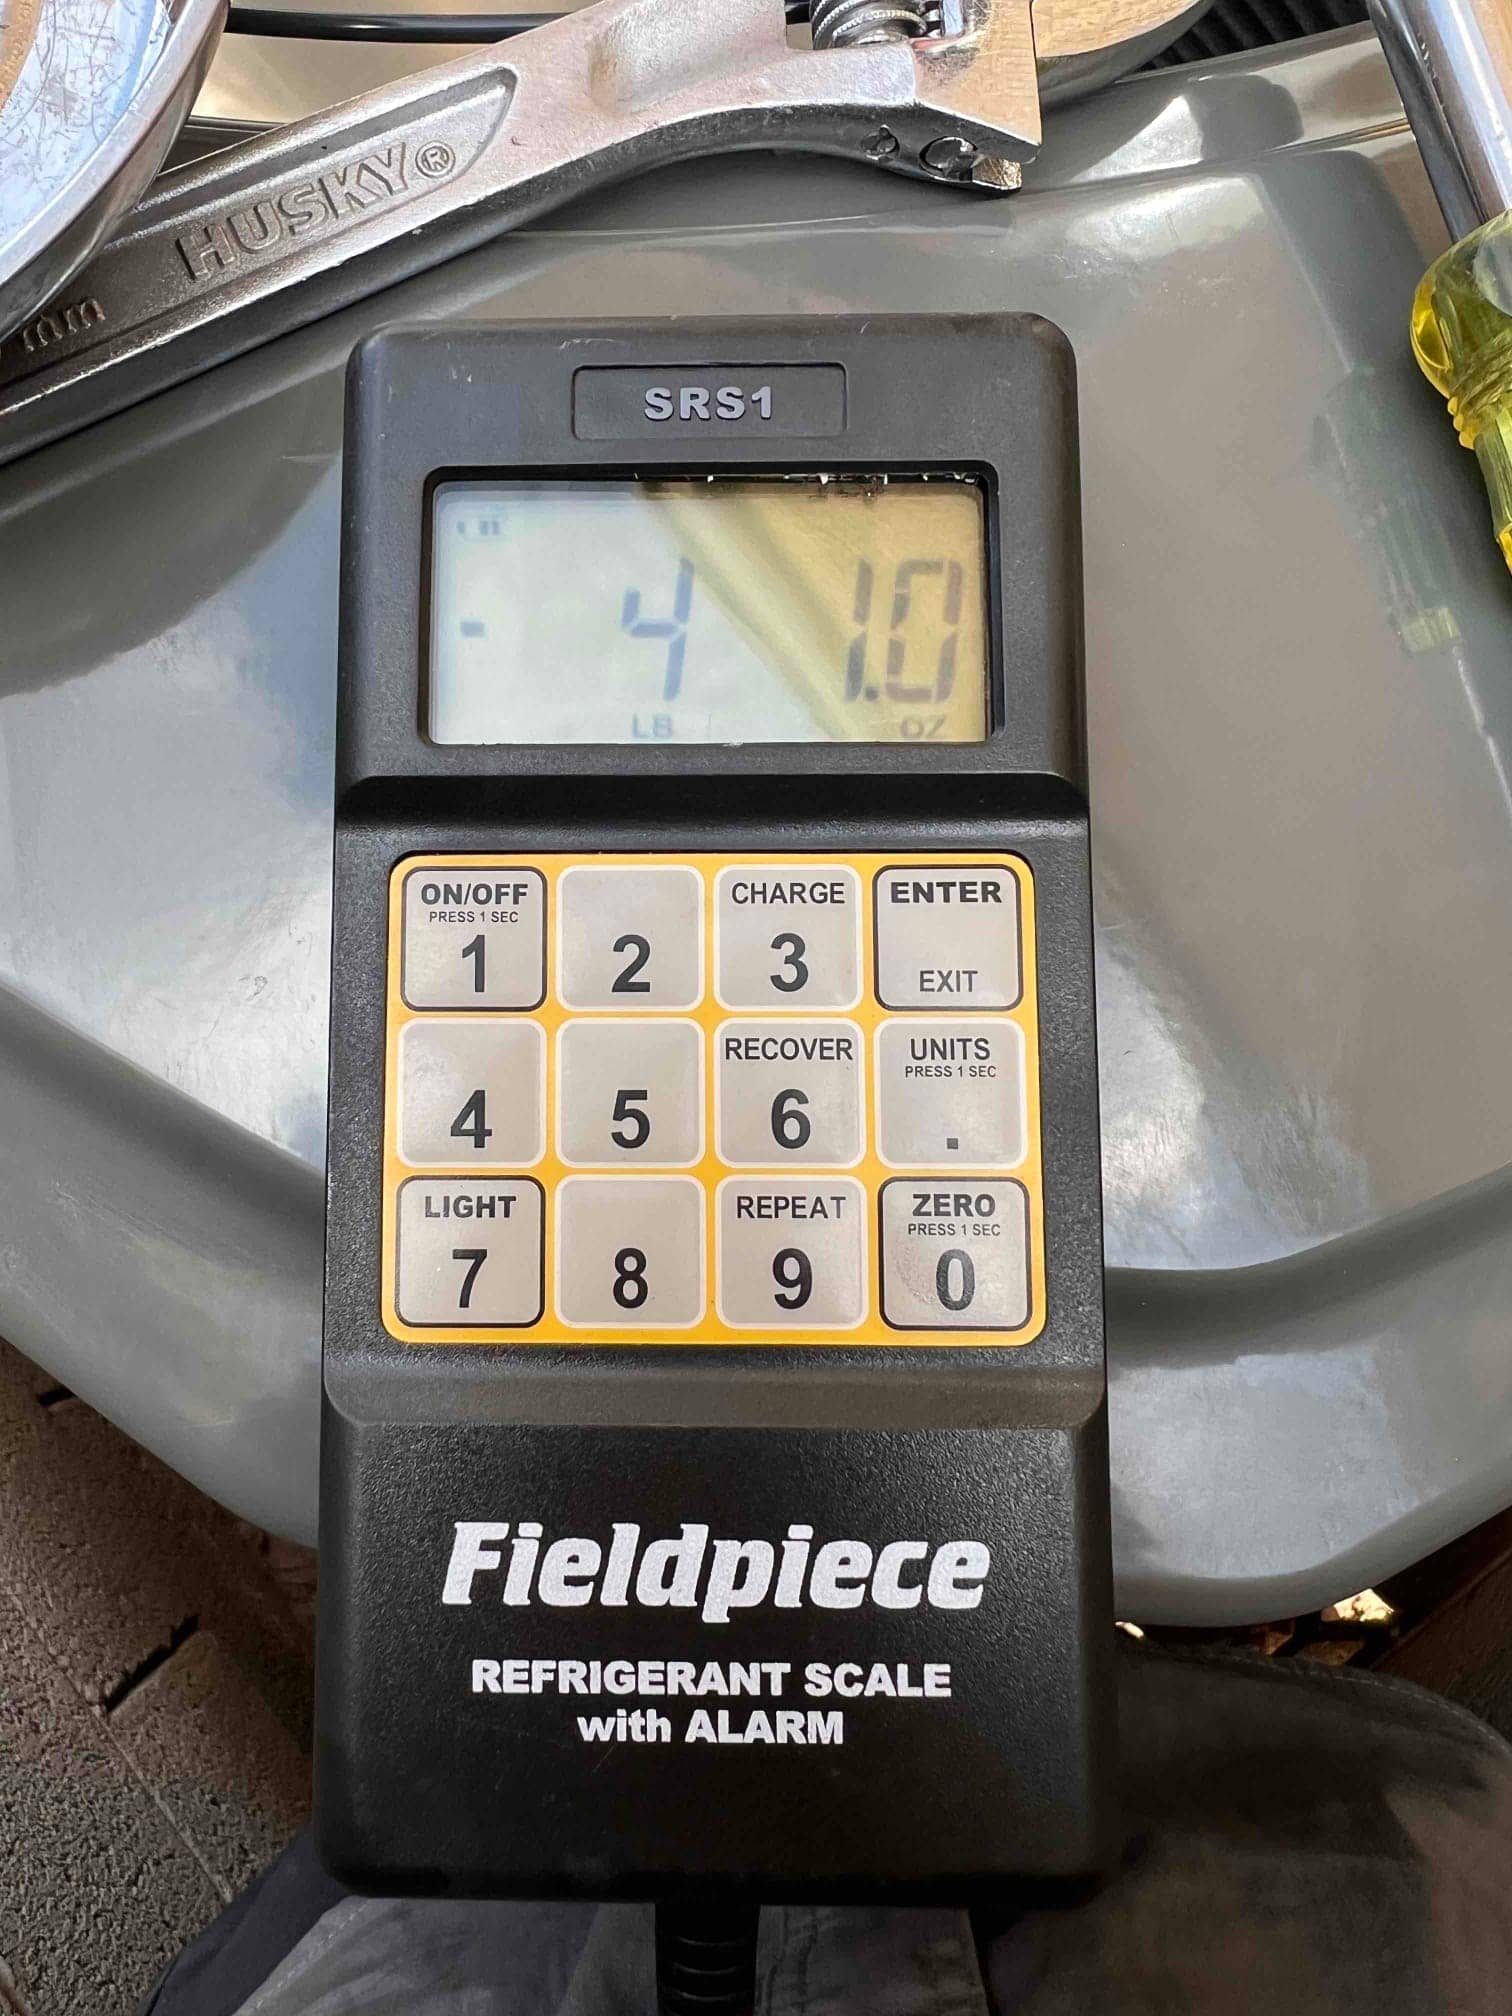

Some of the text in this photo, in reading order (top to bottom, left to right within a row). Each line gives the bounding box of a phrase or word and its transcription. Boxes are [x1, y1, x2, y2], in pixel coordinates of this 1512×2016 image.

[175, 141, 410, 280] HUSKY
[644, 386, 773, 421] SRS1
[621, 558, 694, 701] 4
[631, 712, 672, 738] LB
[902, 714, 947, 737] OZ
[420, 882, 529, 906] ON/OFF
[731, 882, 845, 905] CHARGE
[891, 881, 1002, 904] ENTER
[429, 911, 519, 923] PRESS 1 SEC
[461, 934, 486, 993] 1
[612, 934, 652, 993] 2
[769, 933, 809, 993] 3
[919, 969, 978, 993] EXIT
[725, 1037, 853, 1061] RECOVER
[910, 1038, 991, 1061] UNITS
[905, 1065, 997, 1078] PRESS 1 SEC
[450, 1089, 492, 1149] 4
[611, 1089, 651, 1149] 5
[771, 1089, 811, 1149] 6
[425, 1195, 517, 1219] LIGHT
[737, 1196, 846, 1219] REPEAT
[912, 1193, 996, 1217] ZERO
[908, 1223, 1001, 1236] PRESS 1 SEC
[452, 1249, 488, 1308] 7
[612, 1247, 649, 1308] 8
[773, 1248, 813, 1310] 9
[935, 1250, 975, 1311] 0
[442, 1522, 991, 1624] Fieldpiece
[472, 1659, 952, 1697] REFRIGERANT SCALE
[578, 1709, 844, 1745] with ALARM
